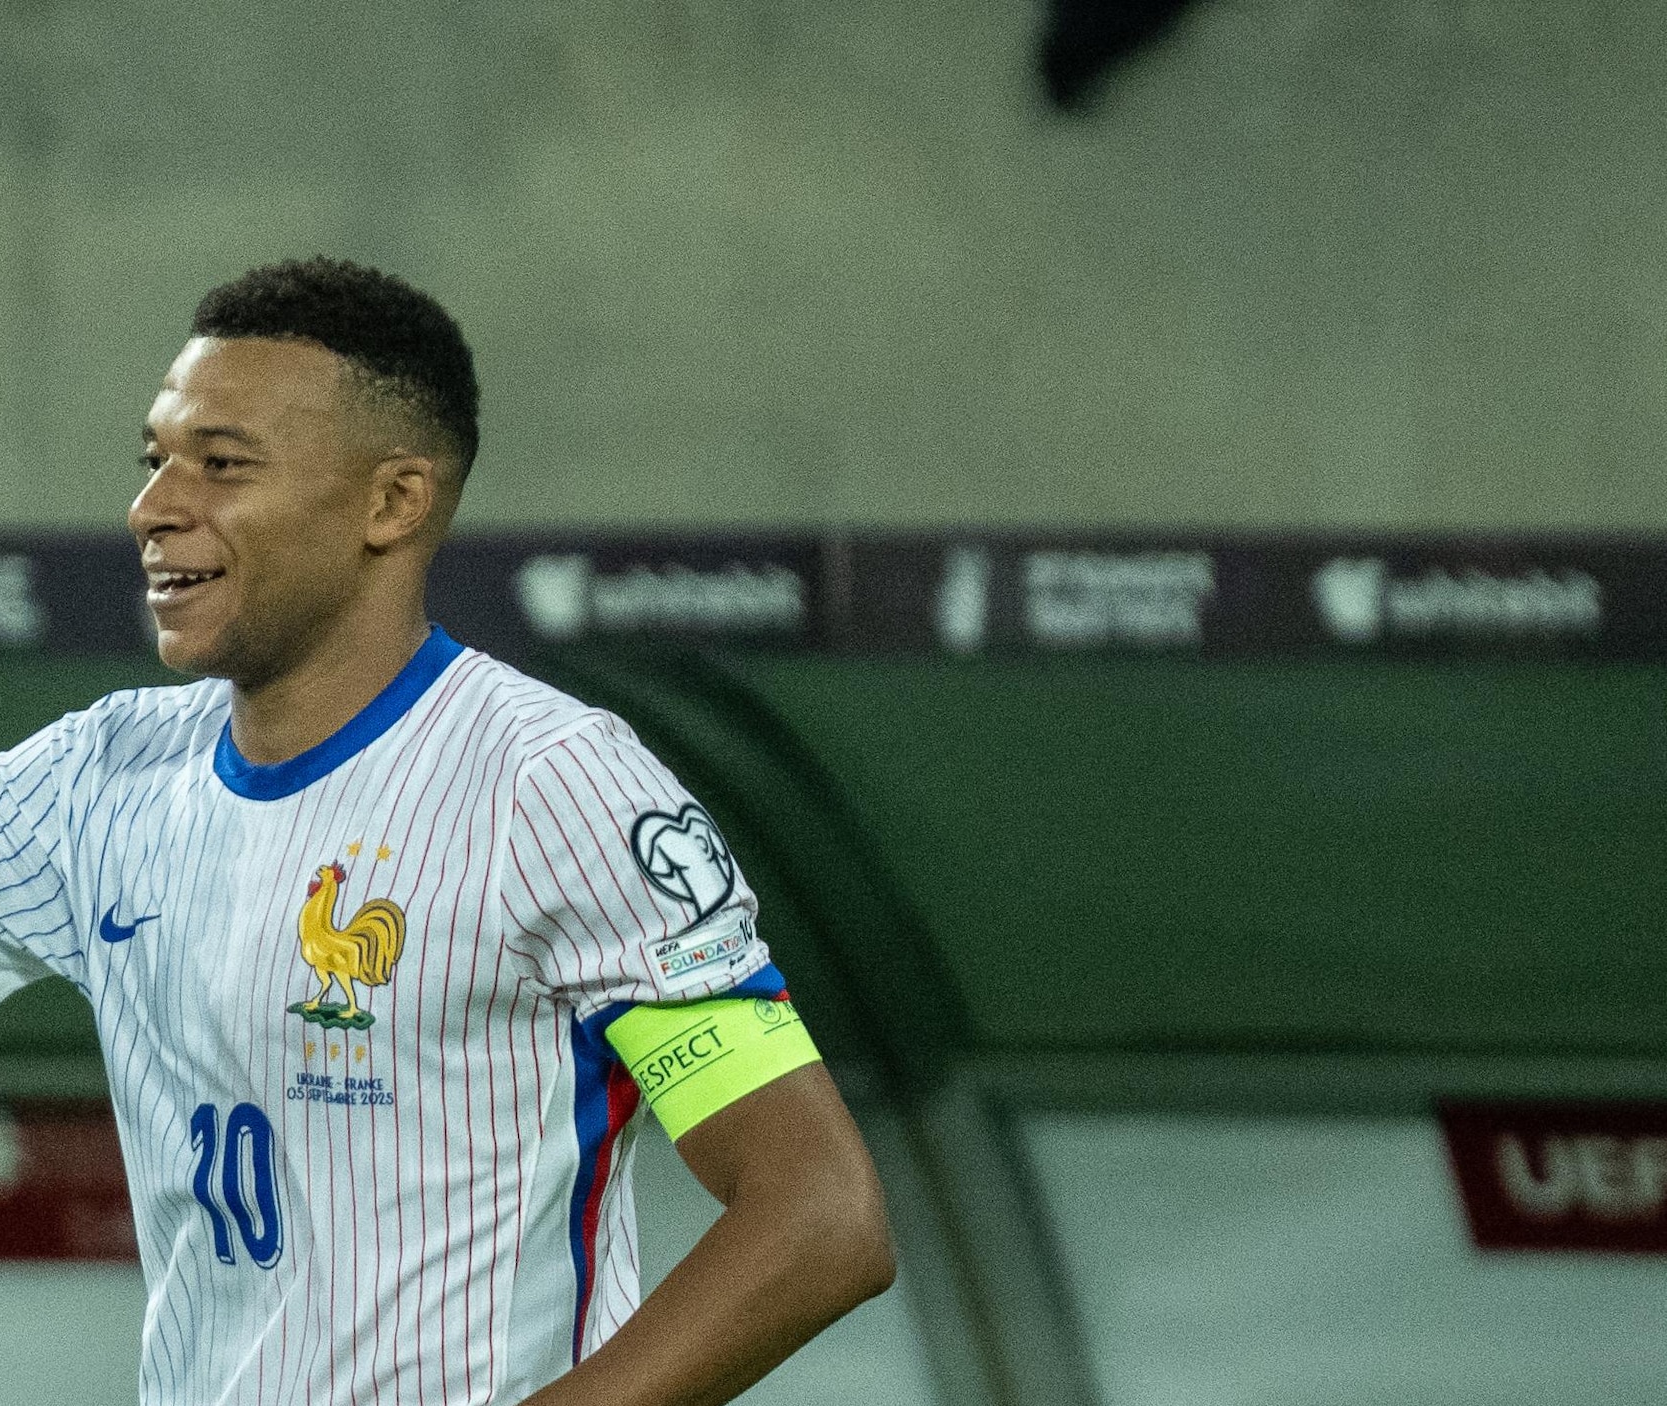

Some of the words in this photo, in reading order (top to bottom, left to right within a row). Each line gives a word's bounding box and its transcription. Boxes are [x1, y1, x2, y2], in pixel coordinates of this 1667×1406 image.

[655, 940, 681, 957] UEFA
[344, 1077, 384, 1091] FRANCE
[287, 1086, 305, 1100] 05
[360, 1091, 395, 1105] 2025
[190, 1102, 284, 1269] 10
